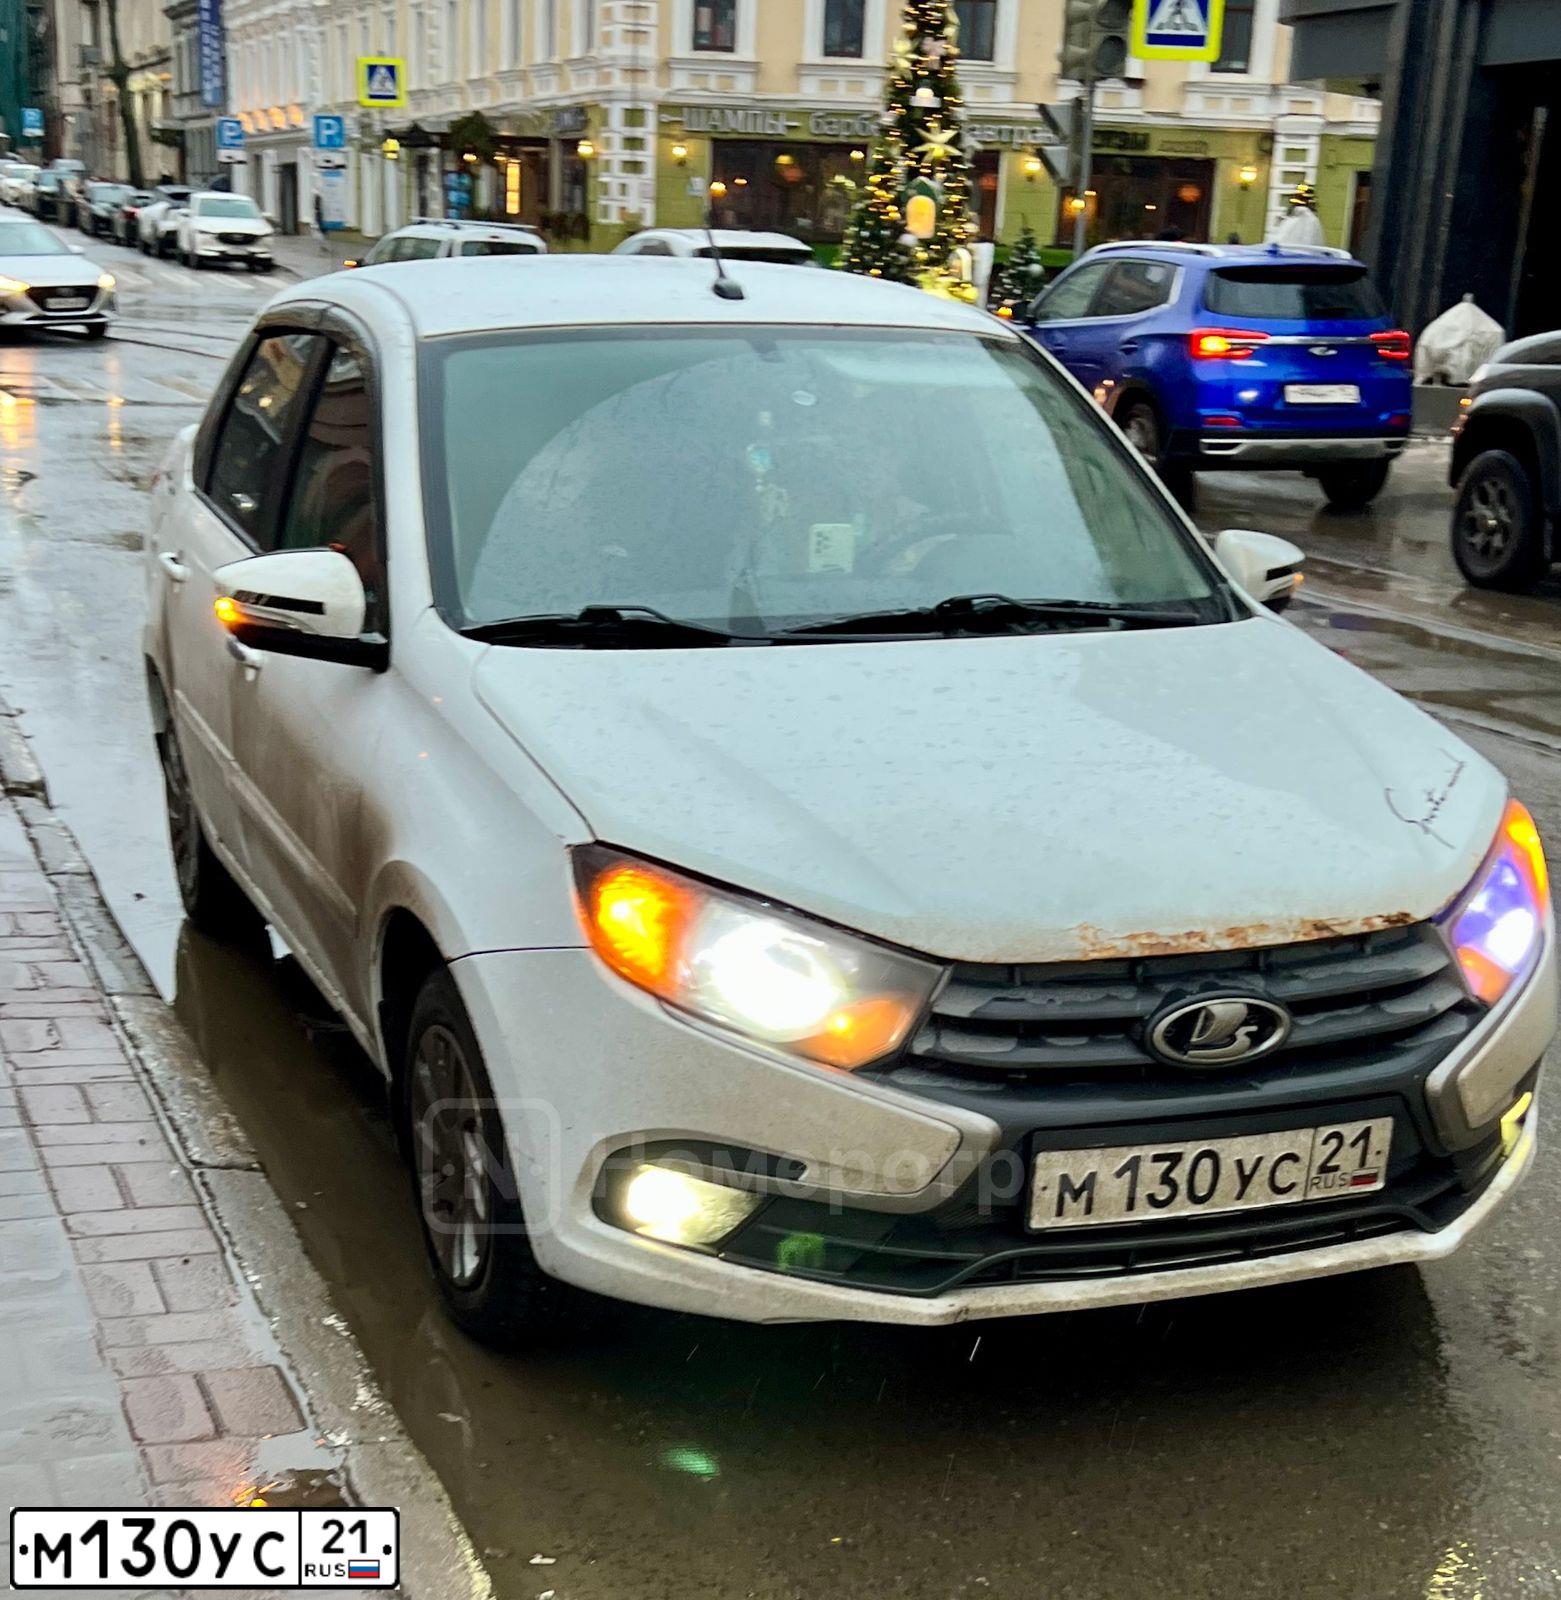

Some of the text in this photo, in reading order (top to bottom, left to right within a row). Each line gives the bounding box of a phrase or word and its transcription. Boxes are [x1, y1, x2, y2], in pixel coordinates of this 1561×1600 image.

[225, 121, 243, 144] P
[322, 119, 340, 144] P
[683, 108, 787, 135] ШАМПЫ
[1318, 1127, 1373, 1173] 21
[1309, 1172, 1348, 1191] RUS
